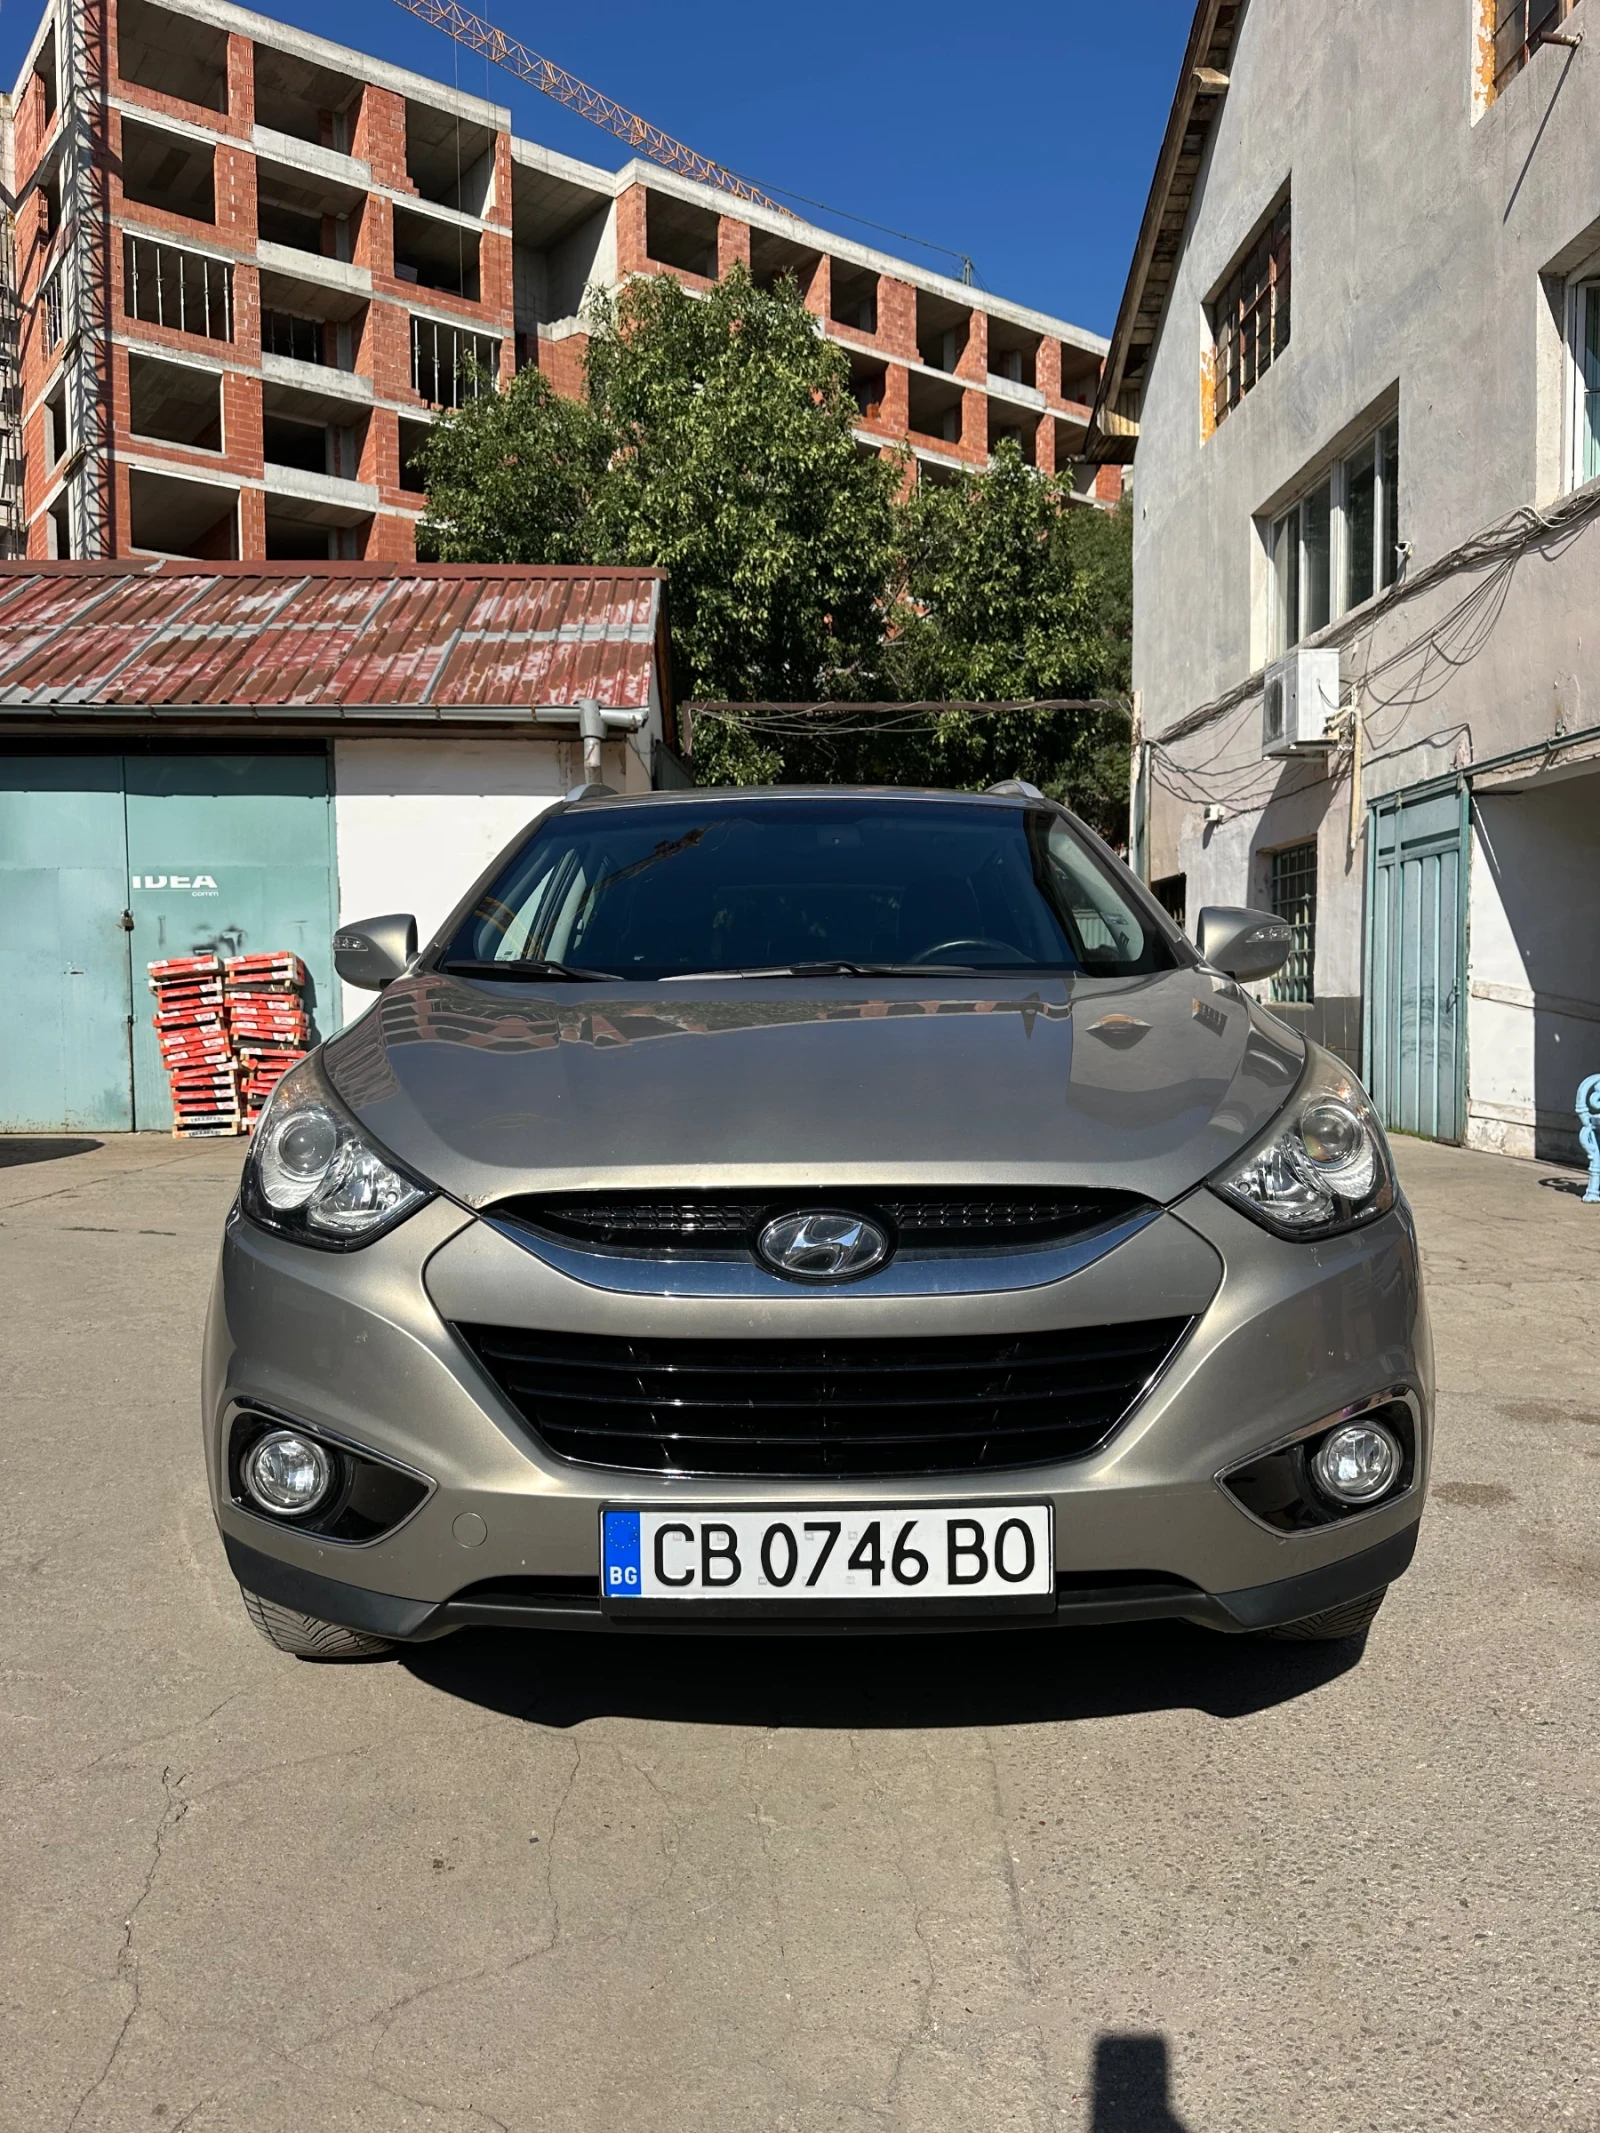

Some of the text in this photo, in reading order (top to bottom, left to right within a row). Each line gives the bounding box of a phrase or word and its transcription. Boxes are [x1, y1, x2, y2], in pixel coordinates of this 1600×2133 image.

[132, 875, 218, 889] IDEA
[653, 1518, 1036, 1587] CB 0746 BO
[609, 1566, 638, 1586] BG
